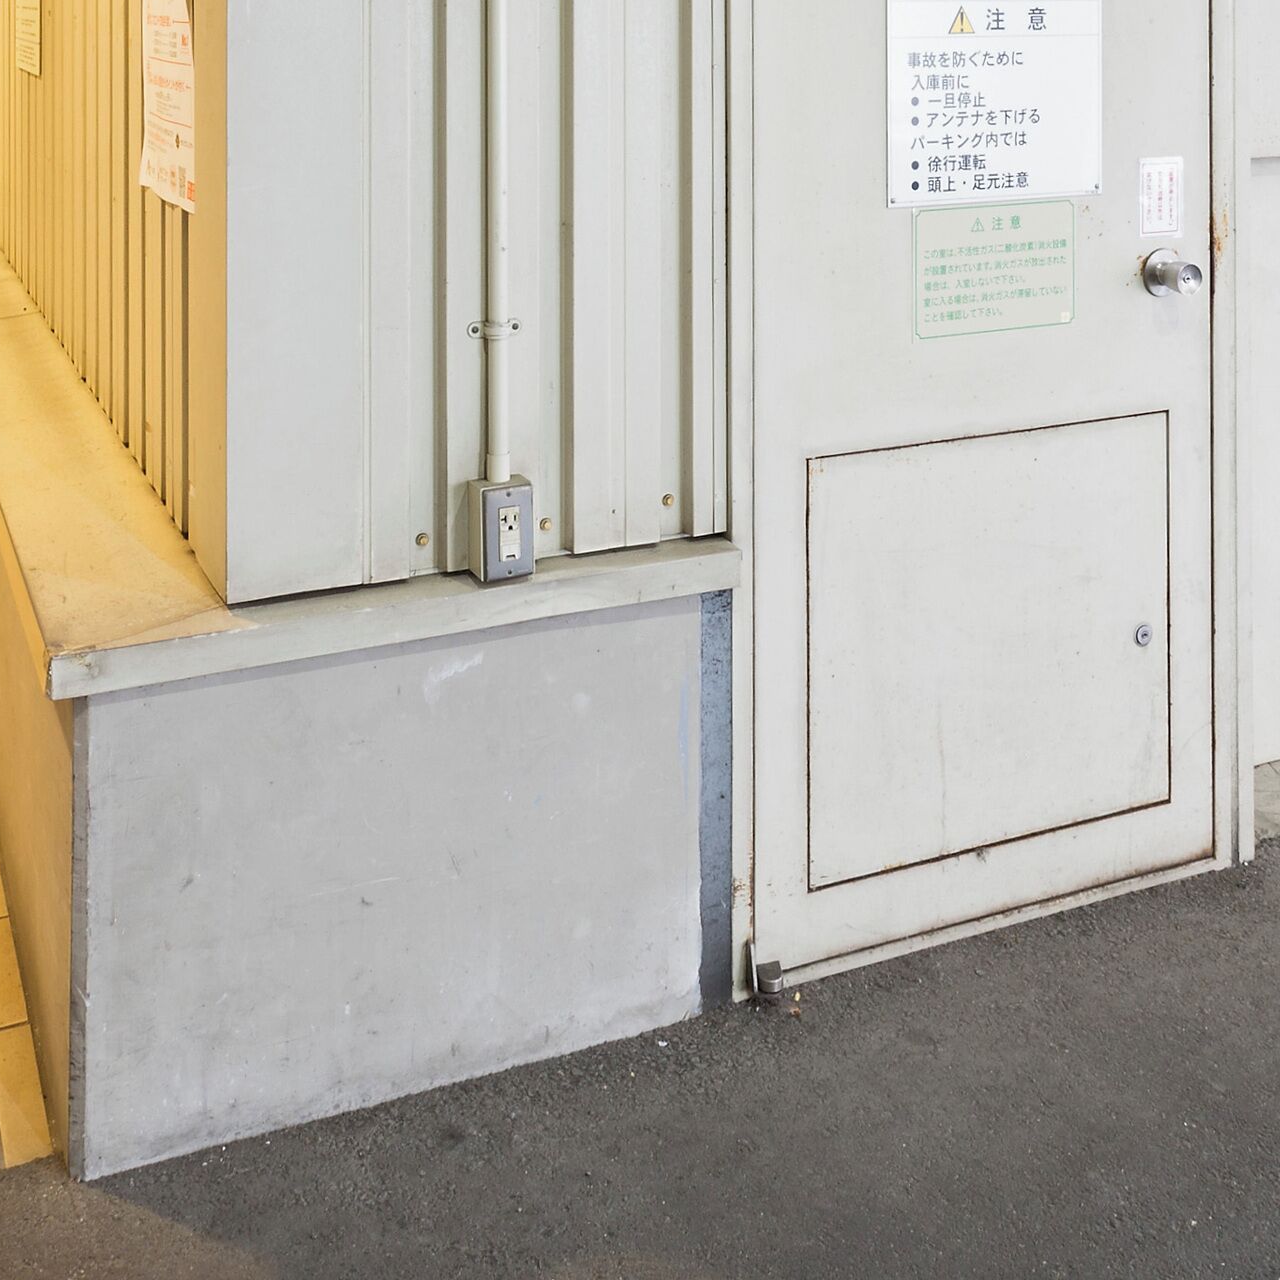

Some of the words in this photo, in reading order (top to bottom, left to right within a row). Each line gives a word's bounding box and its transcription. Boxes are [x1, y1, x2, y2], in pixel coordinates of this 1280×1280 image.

[986, 8, 1047, 32] 注意
[908, 50, 1024, 68] 事故を防ぐために
[912, 74, 969, 90] 入庫前に
[928, 92, 986, 108] 一旦停止
[927, 109, 1040, 128] アンテナを下げる
[911, 131, 1027, 150] パーキング内では
[928, 155, 986, 173] 徐行運転
[928, 172, 1029, 193] 頭上・足元注意
